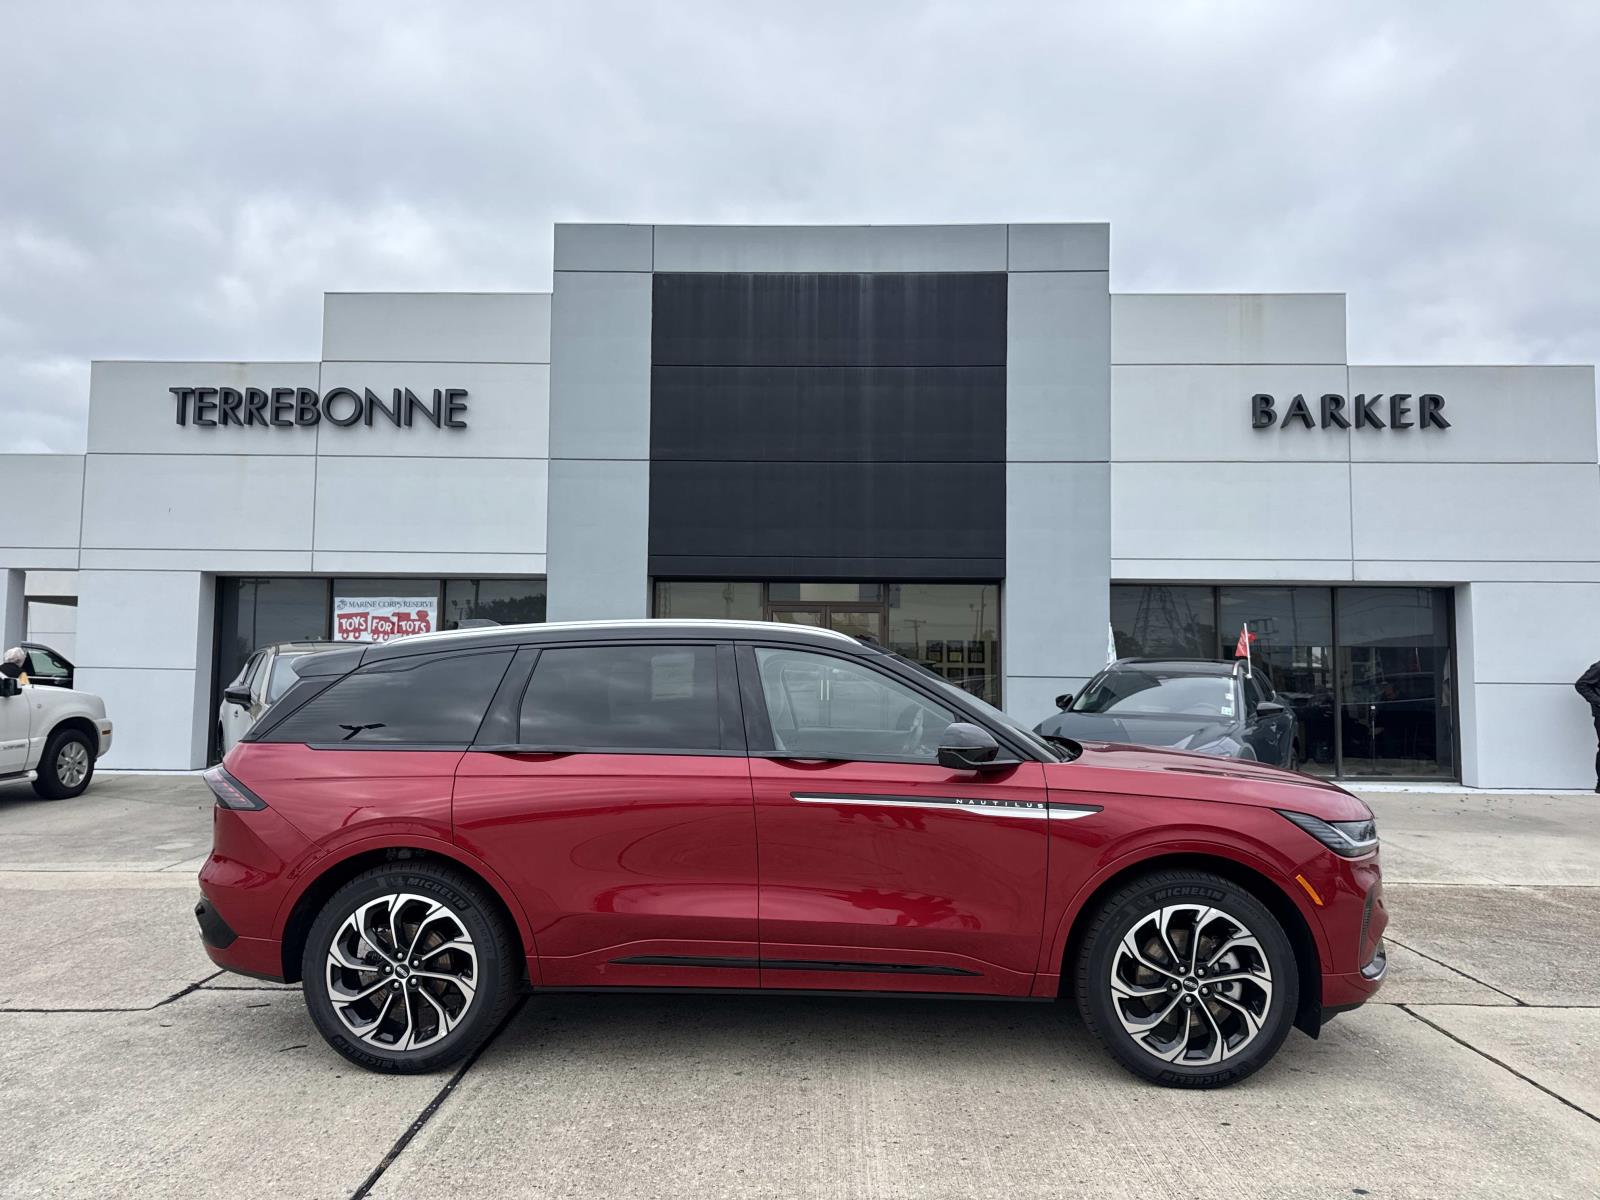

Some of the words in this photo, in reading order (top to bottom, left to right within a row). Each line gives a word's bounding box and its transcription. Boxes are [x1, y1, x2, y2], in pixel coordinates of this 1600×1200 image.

[169, 387, 468, 428] TERREBONNE
[1252, 393, 1452, 429] BARKER
[348, 600, 378, 608] MARINE
[378, 600, 402, 608] CORPS
[403, 600, 433, 608] RESERVE
[340, 616, 366, 630] TOYS
[372, 619, 392, 633] FOR
[399, 620, 426, 633] TOTS
[956, 799, 1044, 809] NAUTILUS
[407, 877, 468, 910] MICHELIN
[1155, 887, 1223, 900] MICHELIN
[333, 1036, 394, 1069] MICHELIN
